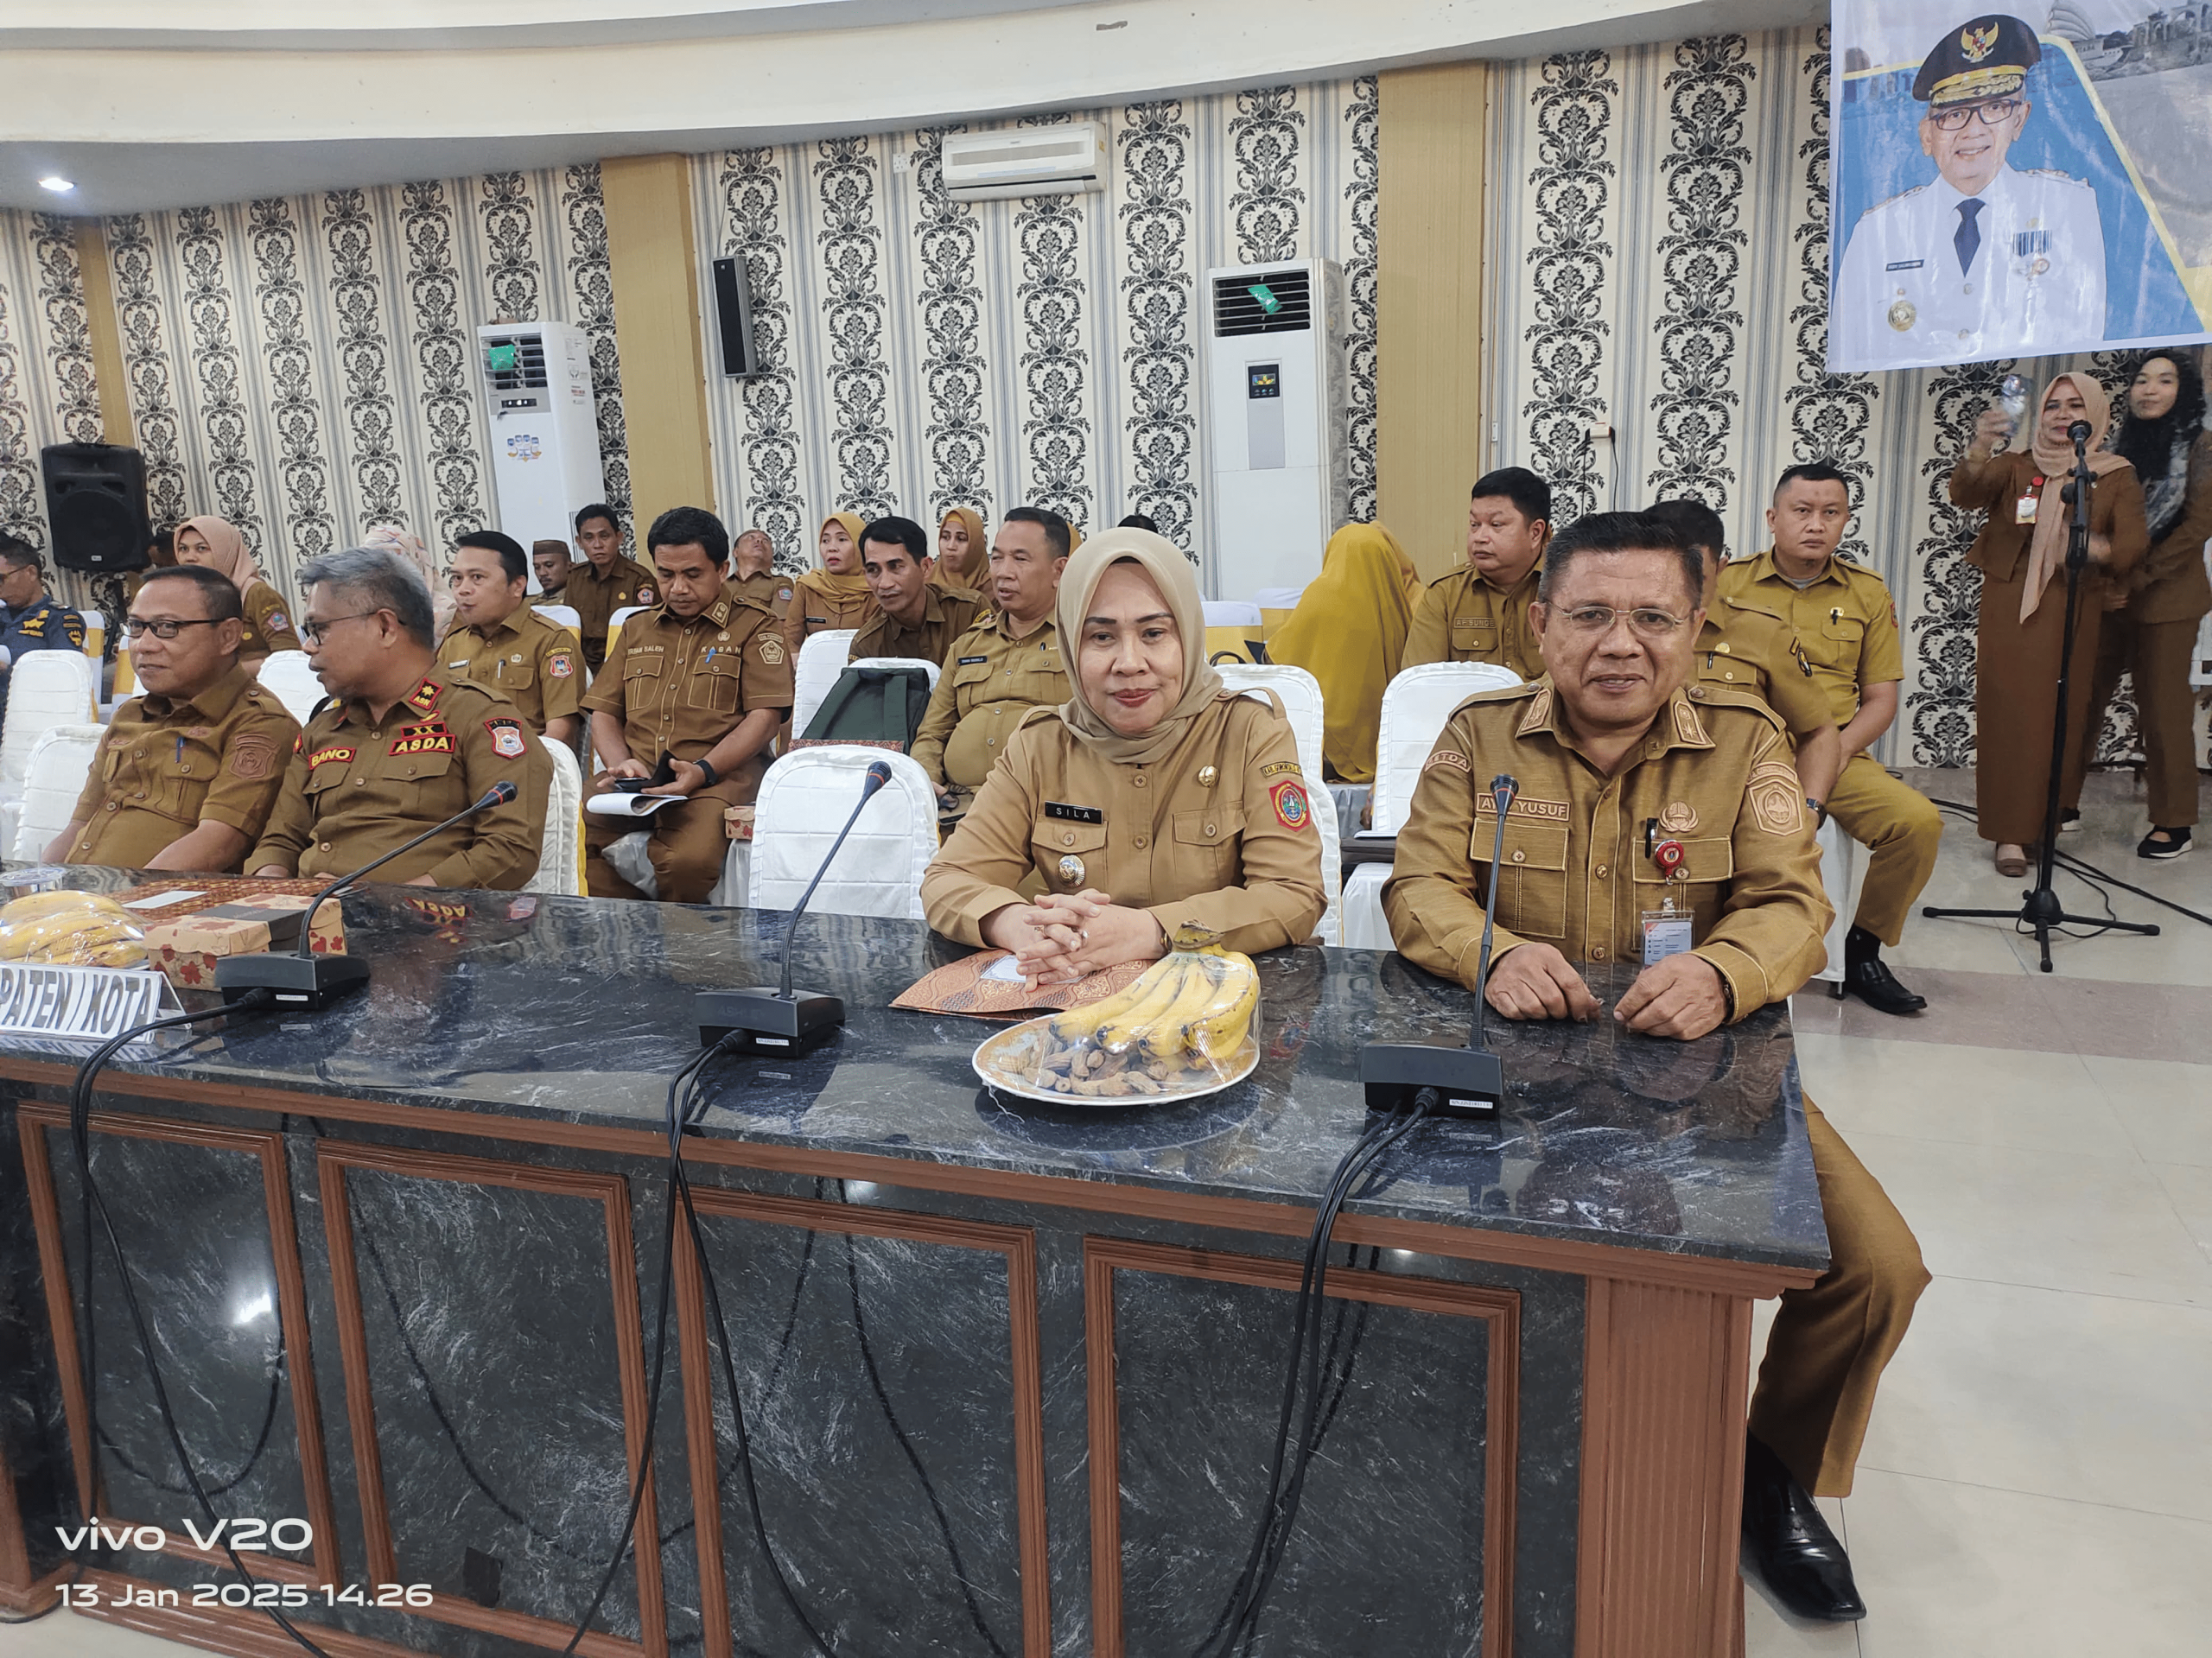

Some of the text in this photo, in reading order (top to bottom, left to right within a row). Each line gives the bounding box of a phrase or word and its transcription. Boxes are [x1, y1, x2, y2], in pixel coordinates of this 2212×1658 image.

[395, 736, 449, 753] ASDA
[311, 748, 351, 767] BANO
[1055, 807, 1090, 820] SILA
[1518, 800, 1567, 817] YUSUF
[80, 974, 152, 1035] KOTA
